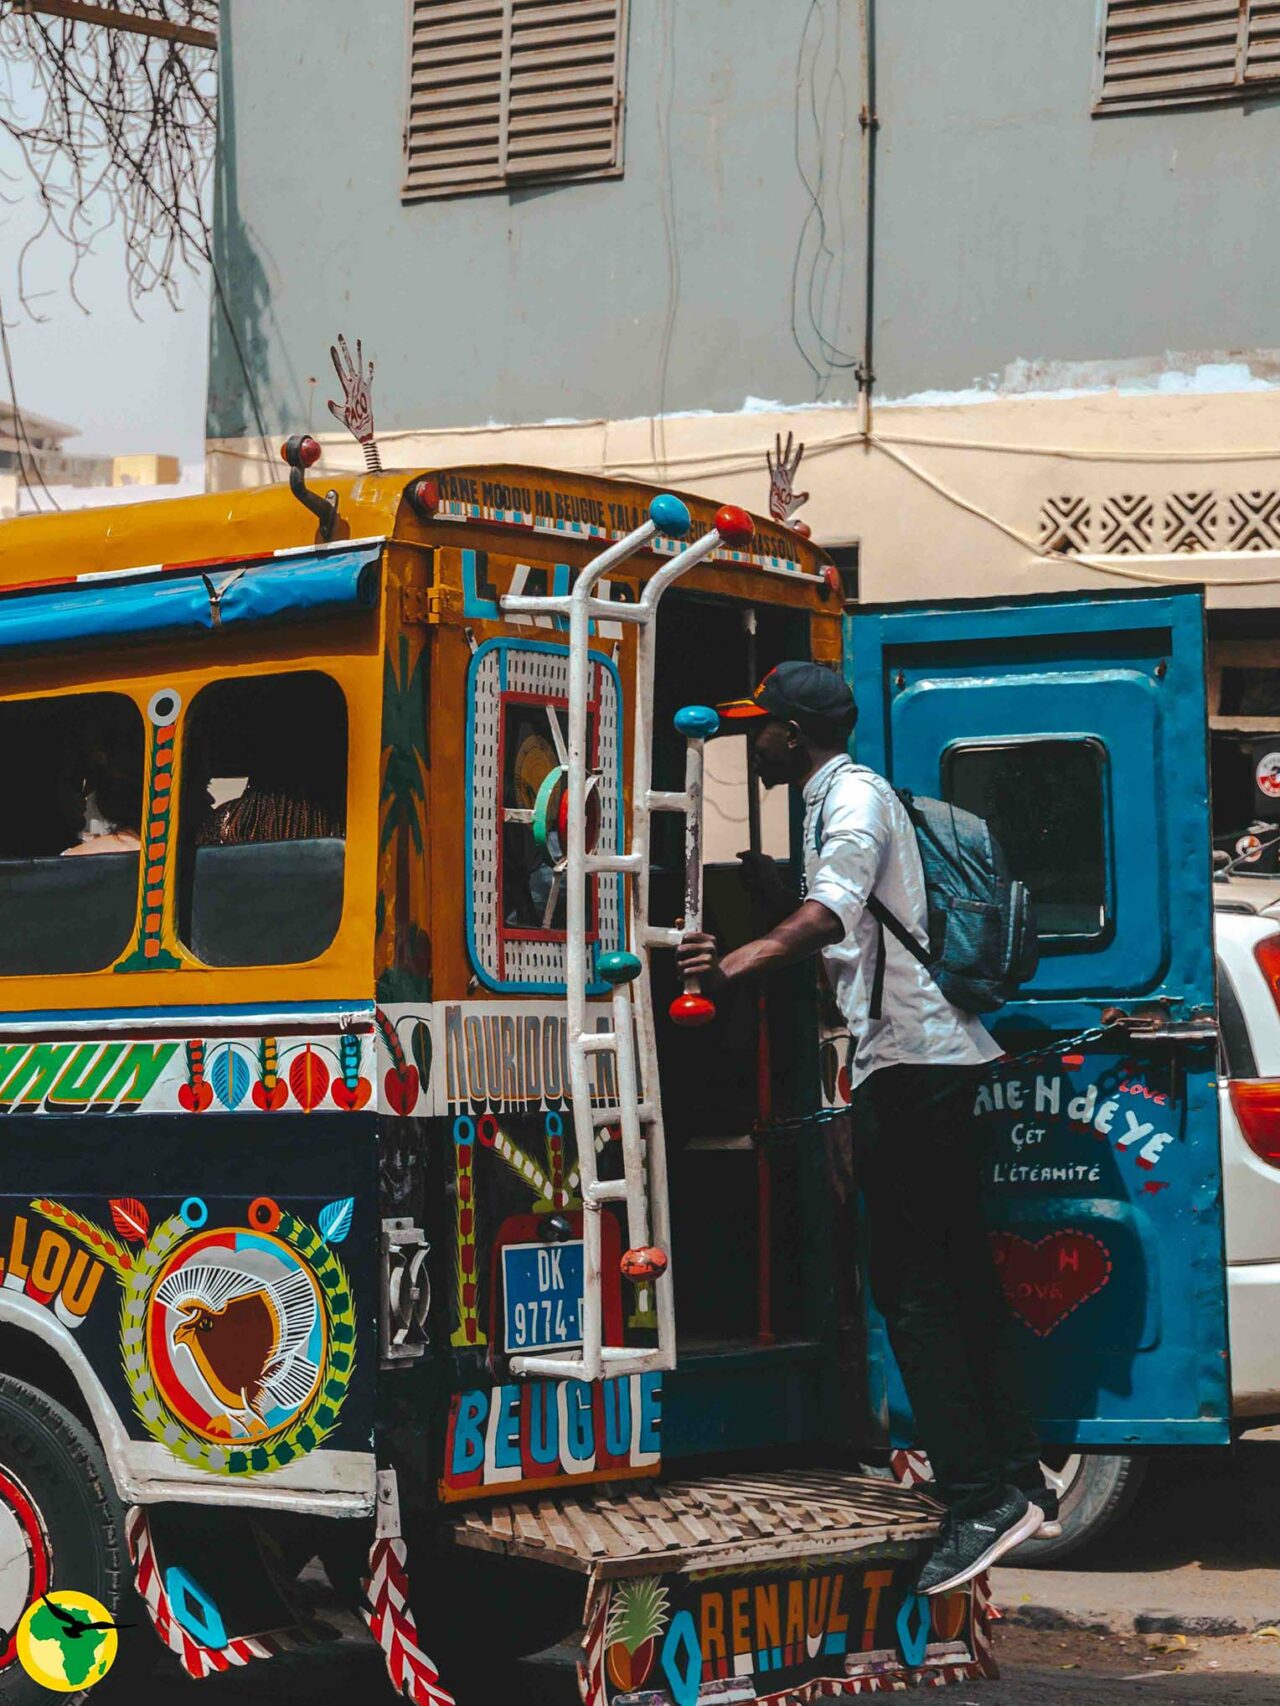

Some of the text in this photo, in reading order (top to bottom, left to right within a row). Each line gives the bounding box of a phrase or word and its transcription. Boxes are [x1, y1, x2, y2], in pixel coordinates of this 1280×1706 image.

[1119, 1079, 1168, 1106] LOVE
[537, 1249, 565, 1293] DK
[444, 1371, 663, 1490] BEUGUE
[700, 1569, 894, 1683] RENAULT
